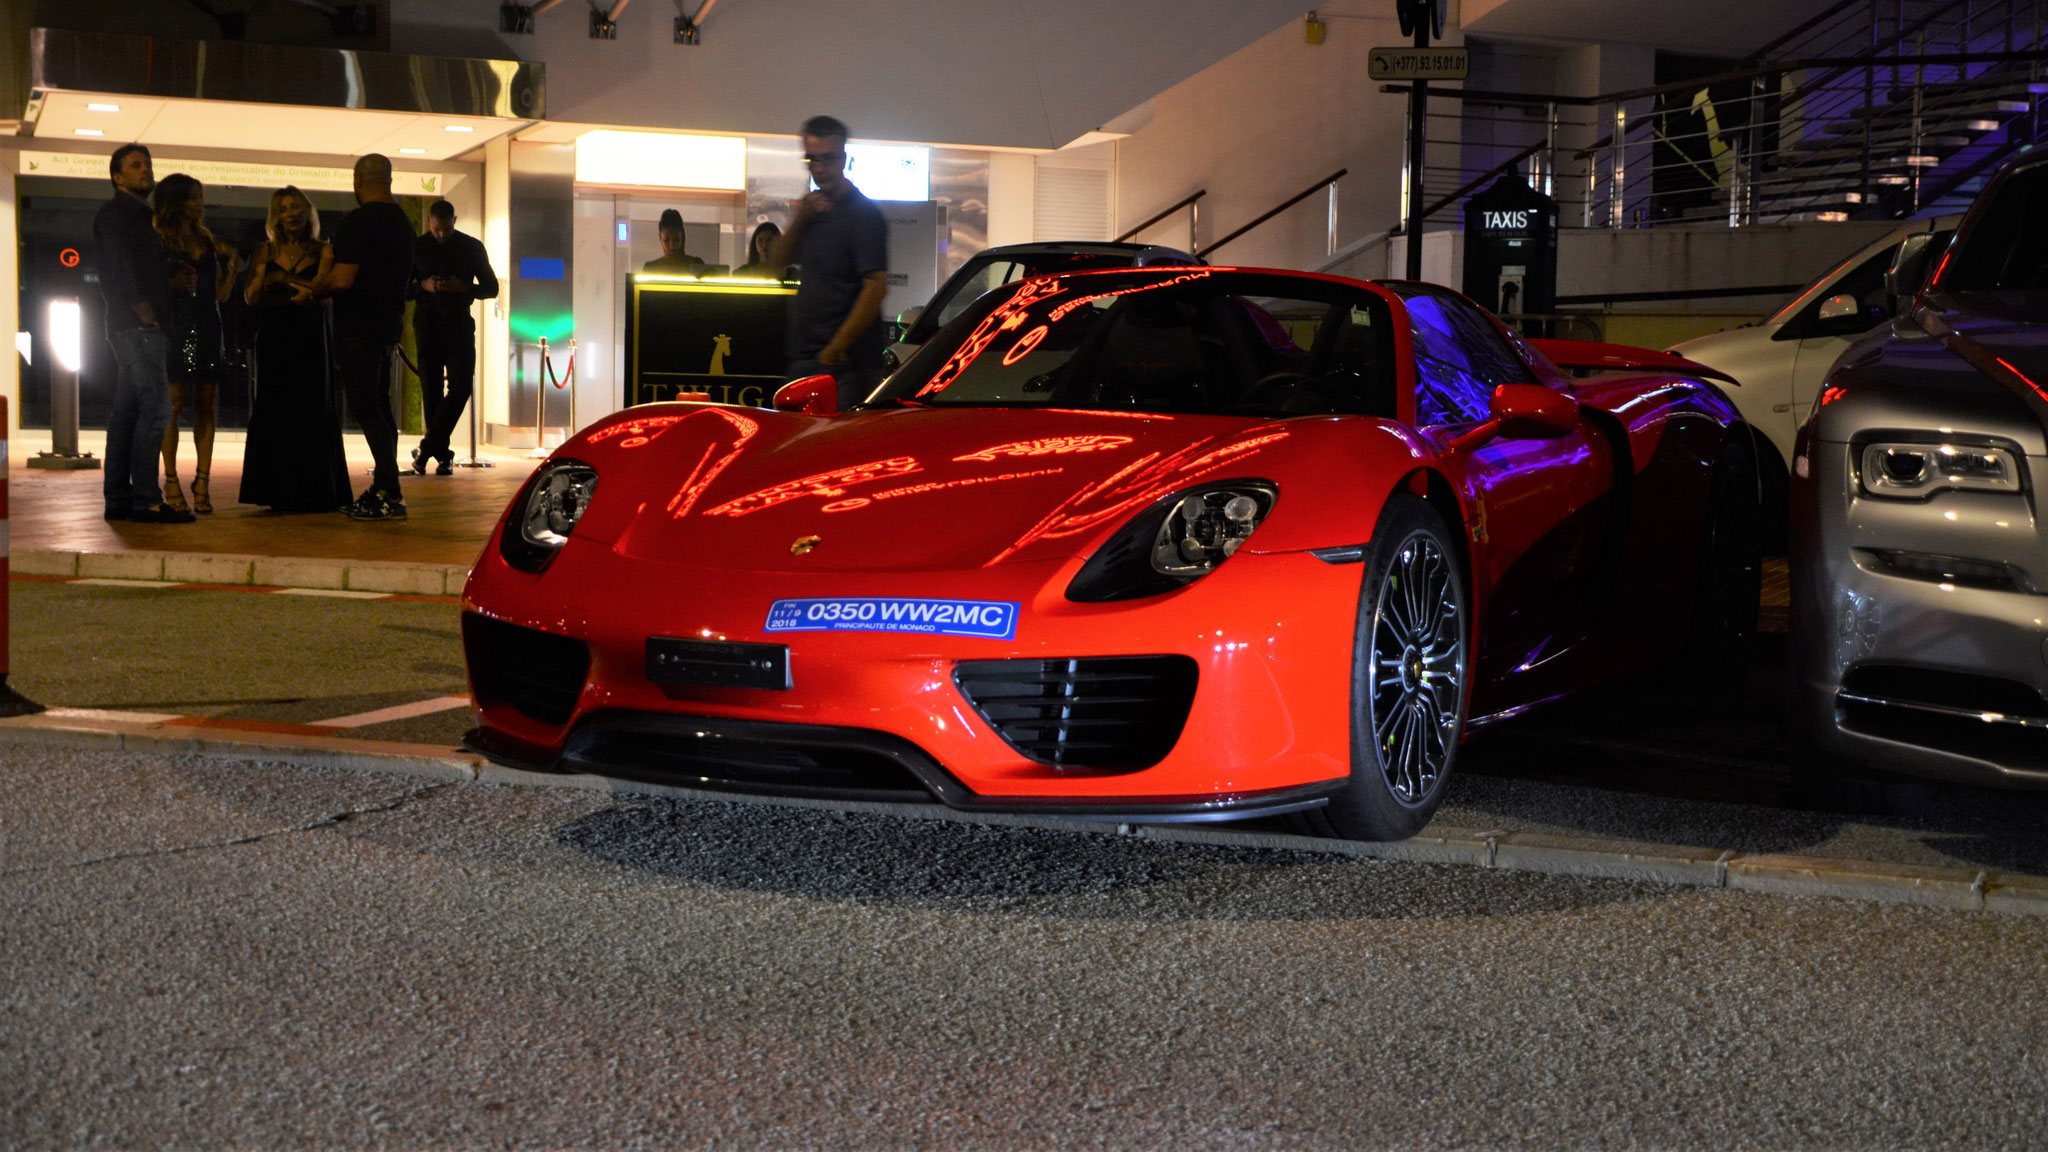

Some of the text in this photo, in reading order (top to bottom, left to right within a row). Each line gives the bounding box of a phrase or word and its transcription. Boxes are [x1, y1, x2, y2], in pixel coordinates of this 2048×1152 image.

[51, 155, 69, 165] Act
[73, 156, 105, 166] Green
[273, 166, 286, 176] du
[288, 168, 330, 179] Grimaldi
[1483, 211, 1528, 229] TAXIS
[771, 619, 797, 628] 2018
[806, 602, 1003, 627] 0350 WW2MC
[834, 622, 885, 630] PRINCIPAUTE
[899, 624, 935, 632] MONACO
